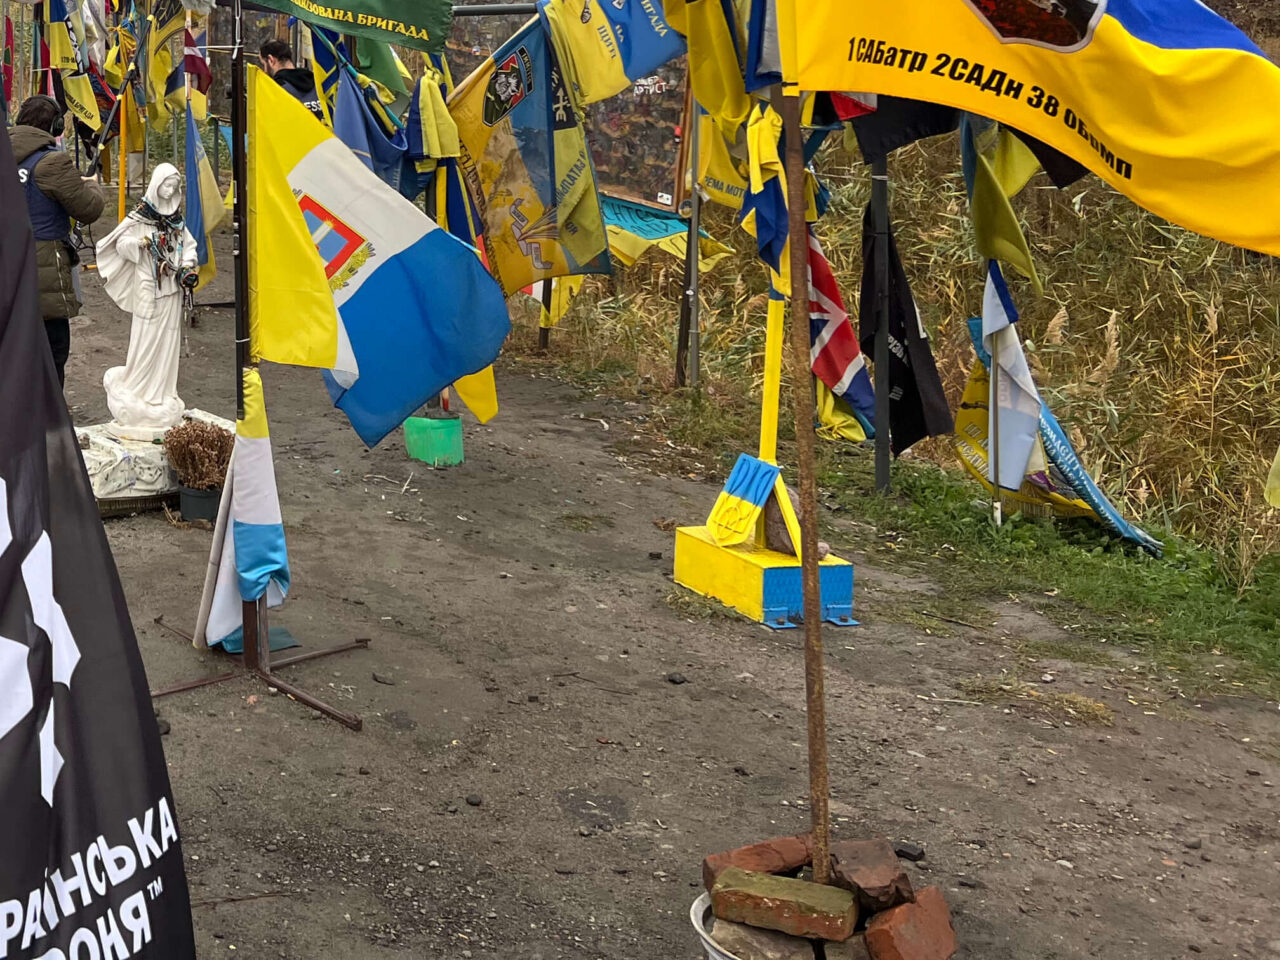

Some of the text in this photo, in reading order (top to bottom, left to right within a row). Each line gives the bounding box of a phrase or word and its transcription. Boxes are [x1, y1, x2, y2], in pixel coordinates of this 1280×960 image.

[356, 13, 430, 42] БРИГАДА
[930, 52, 1023, 101] 2САДн
[1026, 83, 1060, 120] 38
[304, 100, 323, 112] ESS
